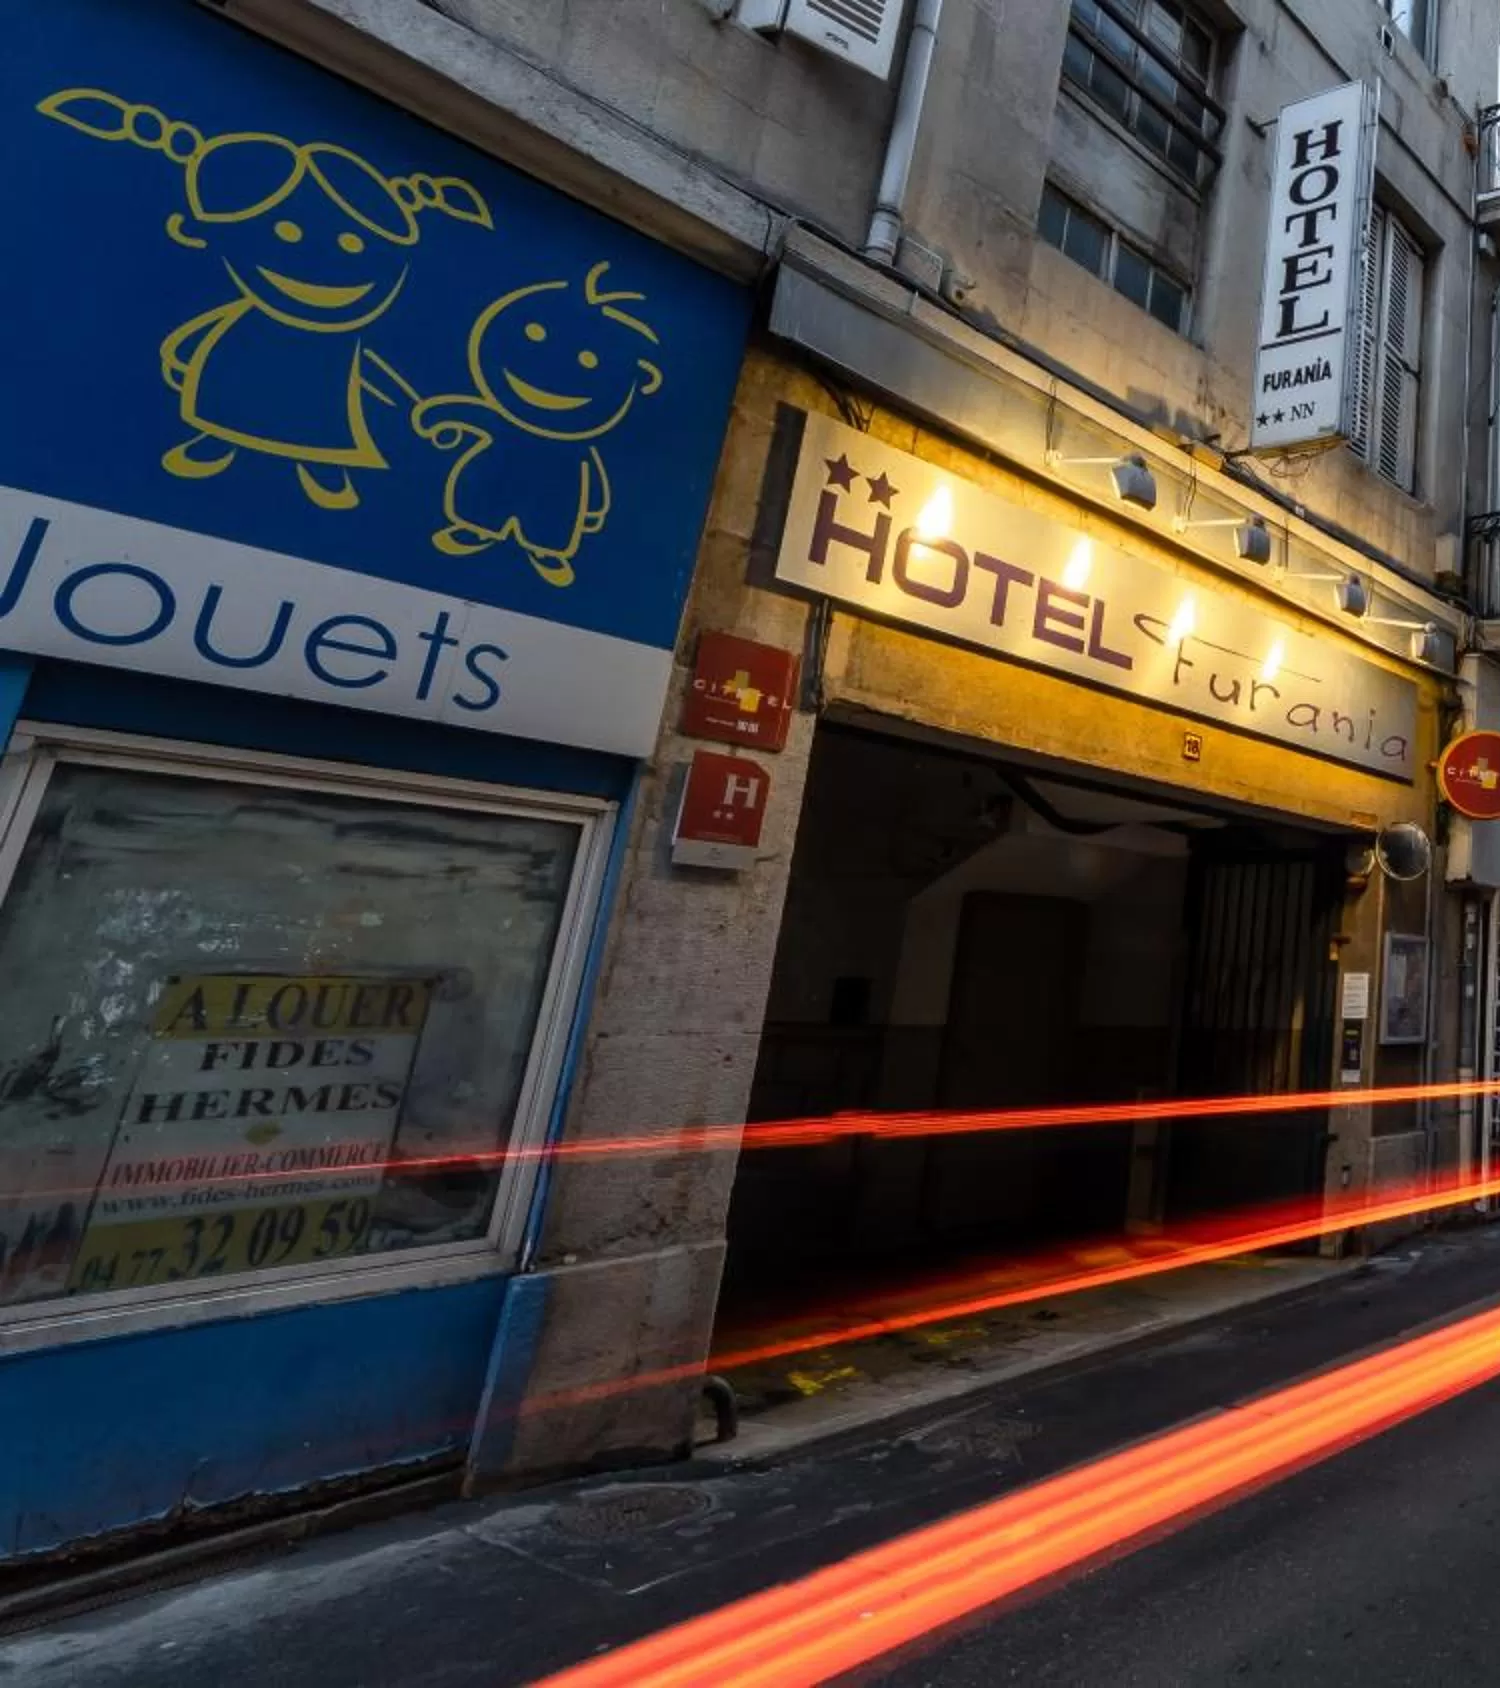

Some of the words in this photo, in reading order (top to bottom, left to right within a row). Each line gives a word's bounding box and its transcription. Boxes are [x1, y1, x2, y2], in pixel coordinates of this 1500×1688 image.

[1275, 119, 1344, 338] HOTEL
[1290, 401, 1316, 421] NN
[808, 489, 1133, 670] HOTEL
[0, 517, 510, 711] Jouets
[723, 773, 759, 809] H
[165, 985, 208, 1031] A
[225, 982, 417, 1031] LOUER
[199, 1038, 375, 1072] FIDES
[134, 1082, 400, 1124] HERMES
[131, 1248, 168, 1281] 77
[168, 1213, 236, 1281] 32
[248, 1206, 306, 1267] 09
[313, 1197, 369, 1258] 59
